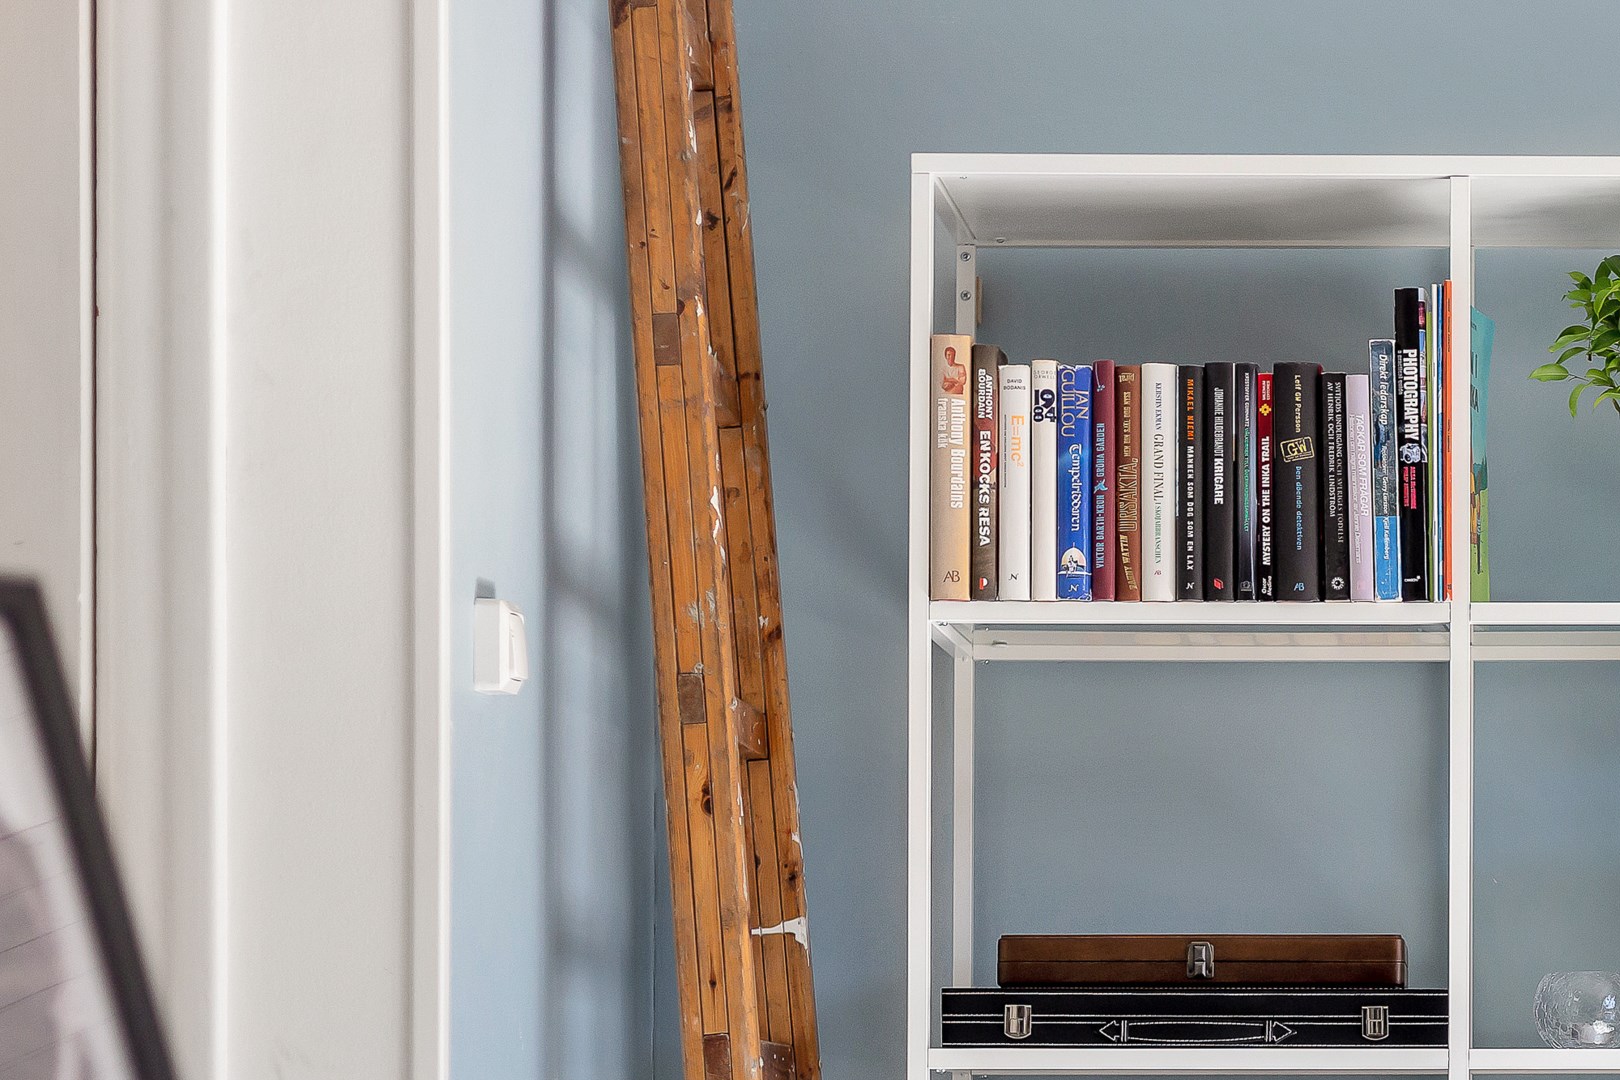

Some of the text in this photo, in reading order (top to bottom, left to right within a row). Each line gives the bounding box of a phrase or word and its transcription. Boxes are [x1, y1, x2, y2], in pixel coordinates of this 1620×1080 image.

[977, 368, 986, 419] BOURDAIN
[985, 374, 993, 420] ANTHONY
[1060, 369, 1076, 437] GUILLOU
[1075, 389, 1089, 419] JAN
[1295, 392, 1301, 402] GW
[1378, 354, 1390, 426] Direkt ledarskap
[1402, 349, 1420, 441] PHOTOGRAPHY
[1294, 403, 1302, 433] Persson
[949, 398, 966, 509] Anthony Bourdains
[1153, 433, 1164, 469] GRAND
[1187, 446, 1195, 479] MANNEN
[1213, 387, 1224, 505] JOHANNE HILDEBRANDT KRIGARE
[978, 430, 991, 547] EN KOCKS RESA
[1069, 443, 1083, 532] Tempelriddaren
[1153, 472, 1164, 501] FINAL
[1187, 482, 1195, 499] SOM
[1261, 436, 1271, 565] MYSTERY ON THE INKA TRAIL
[1295, 481, 1303, 509] döende
[1095, 495, 1105, 540] BARTH-KRON
[1187, 520, 1195, 538] SOM
[1295, 510, 1303, 550] detektiven
[1095, 543, 1105, 569] VIKTOR
[1187, 541, 1195, 552] EN
[1187, 555, 1195, 571] LAX
